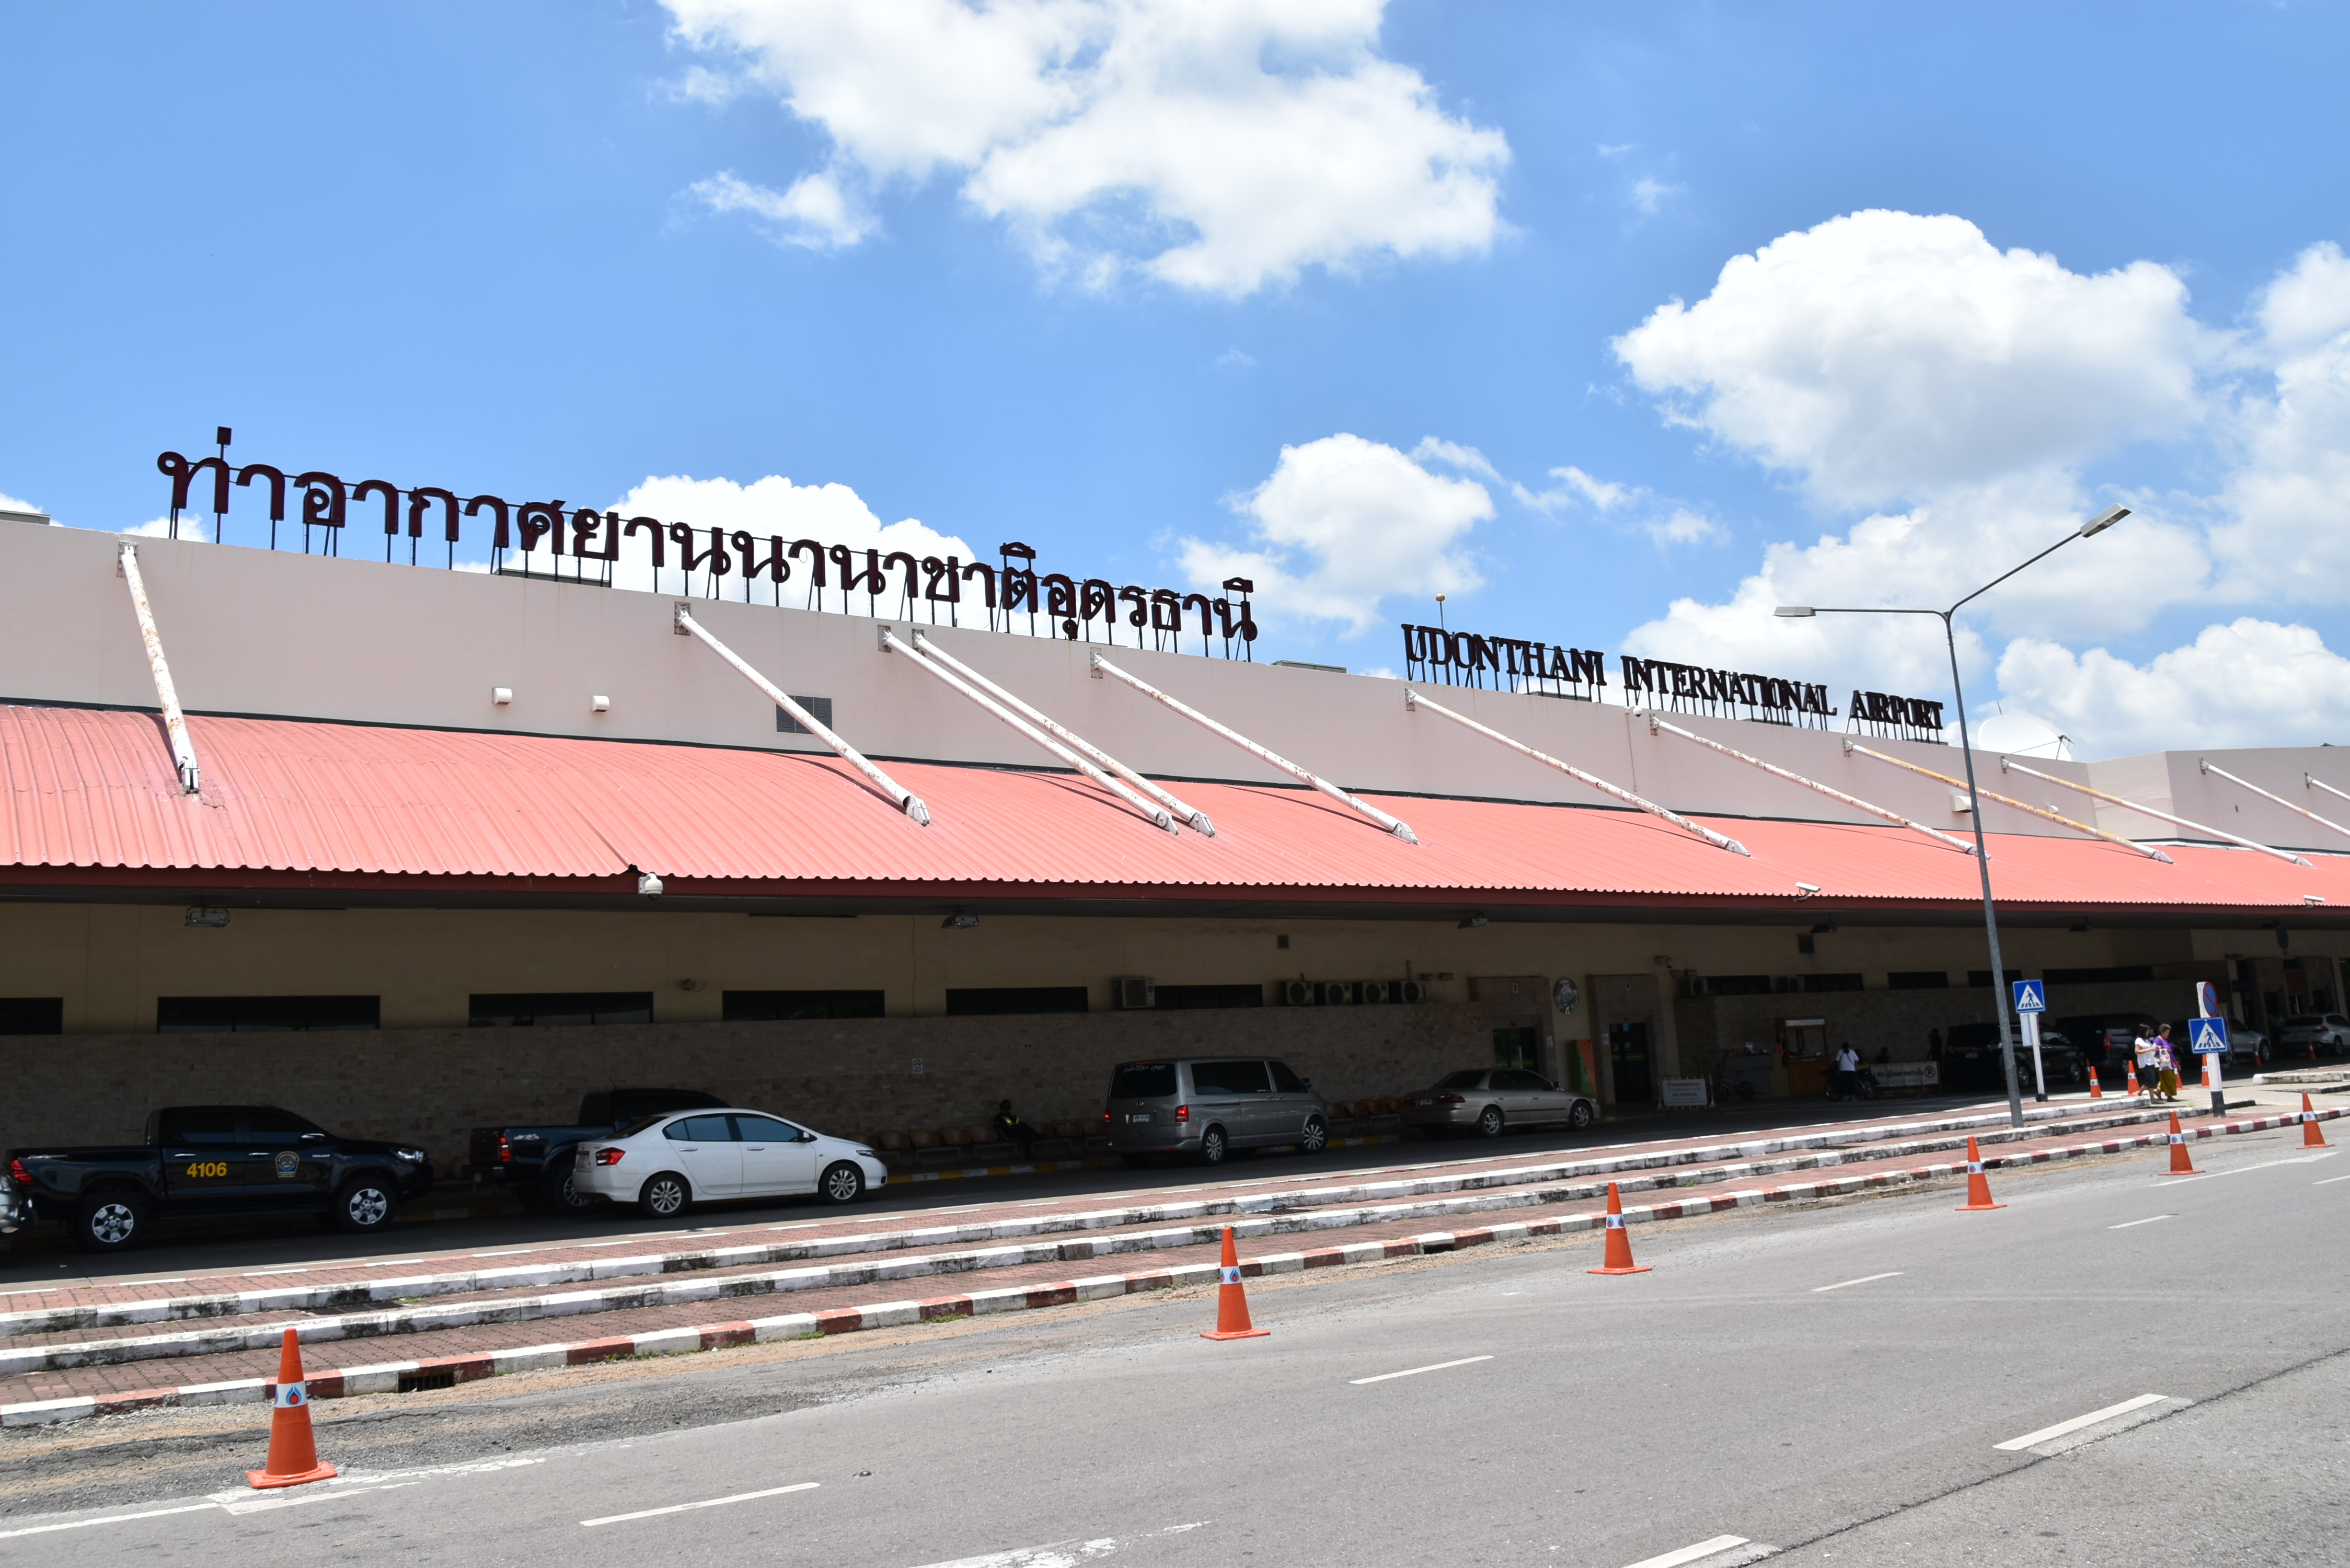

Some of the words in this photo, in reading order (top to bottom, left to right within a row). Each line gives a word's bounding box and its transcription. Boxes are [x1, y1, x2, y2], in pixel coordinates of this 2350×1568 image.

[157, 426, 1258, 641] ท่าอากาศยานนานาชาติอุดรธานี
[1620, 655, 1837, 716] INTERNATIONAL
[1849, 689, 1944, 730] AIRPORT
[187, 1162, 227, 1178] 4106
